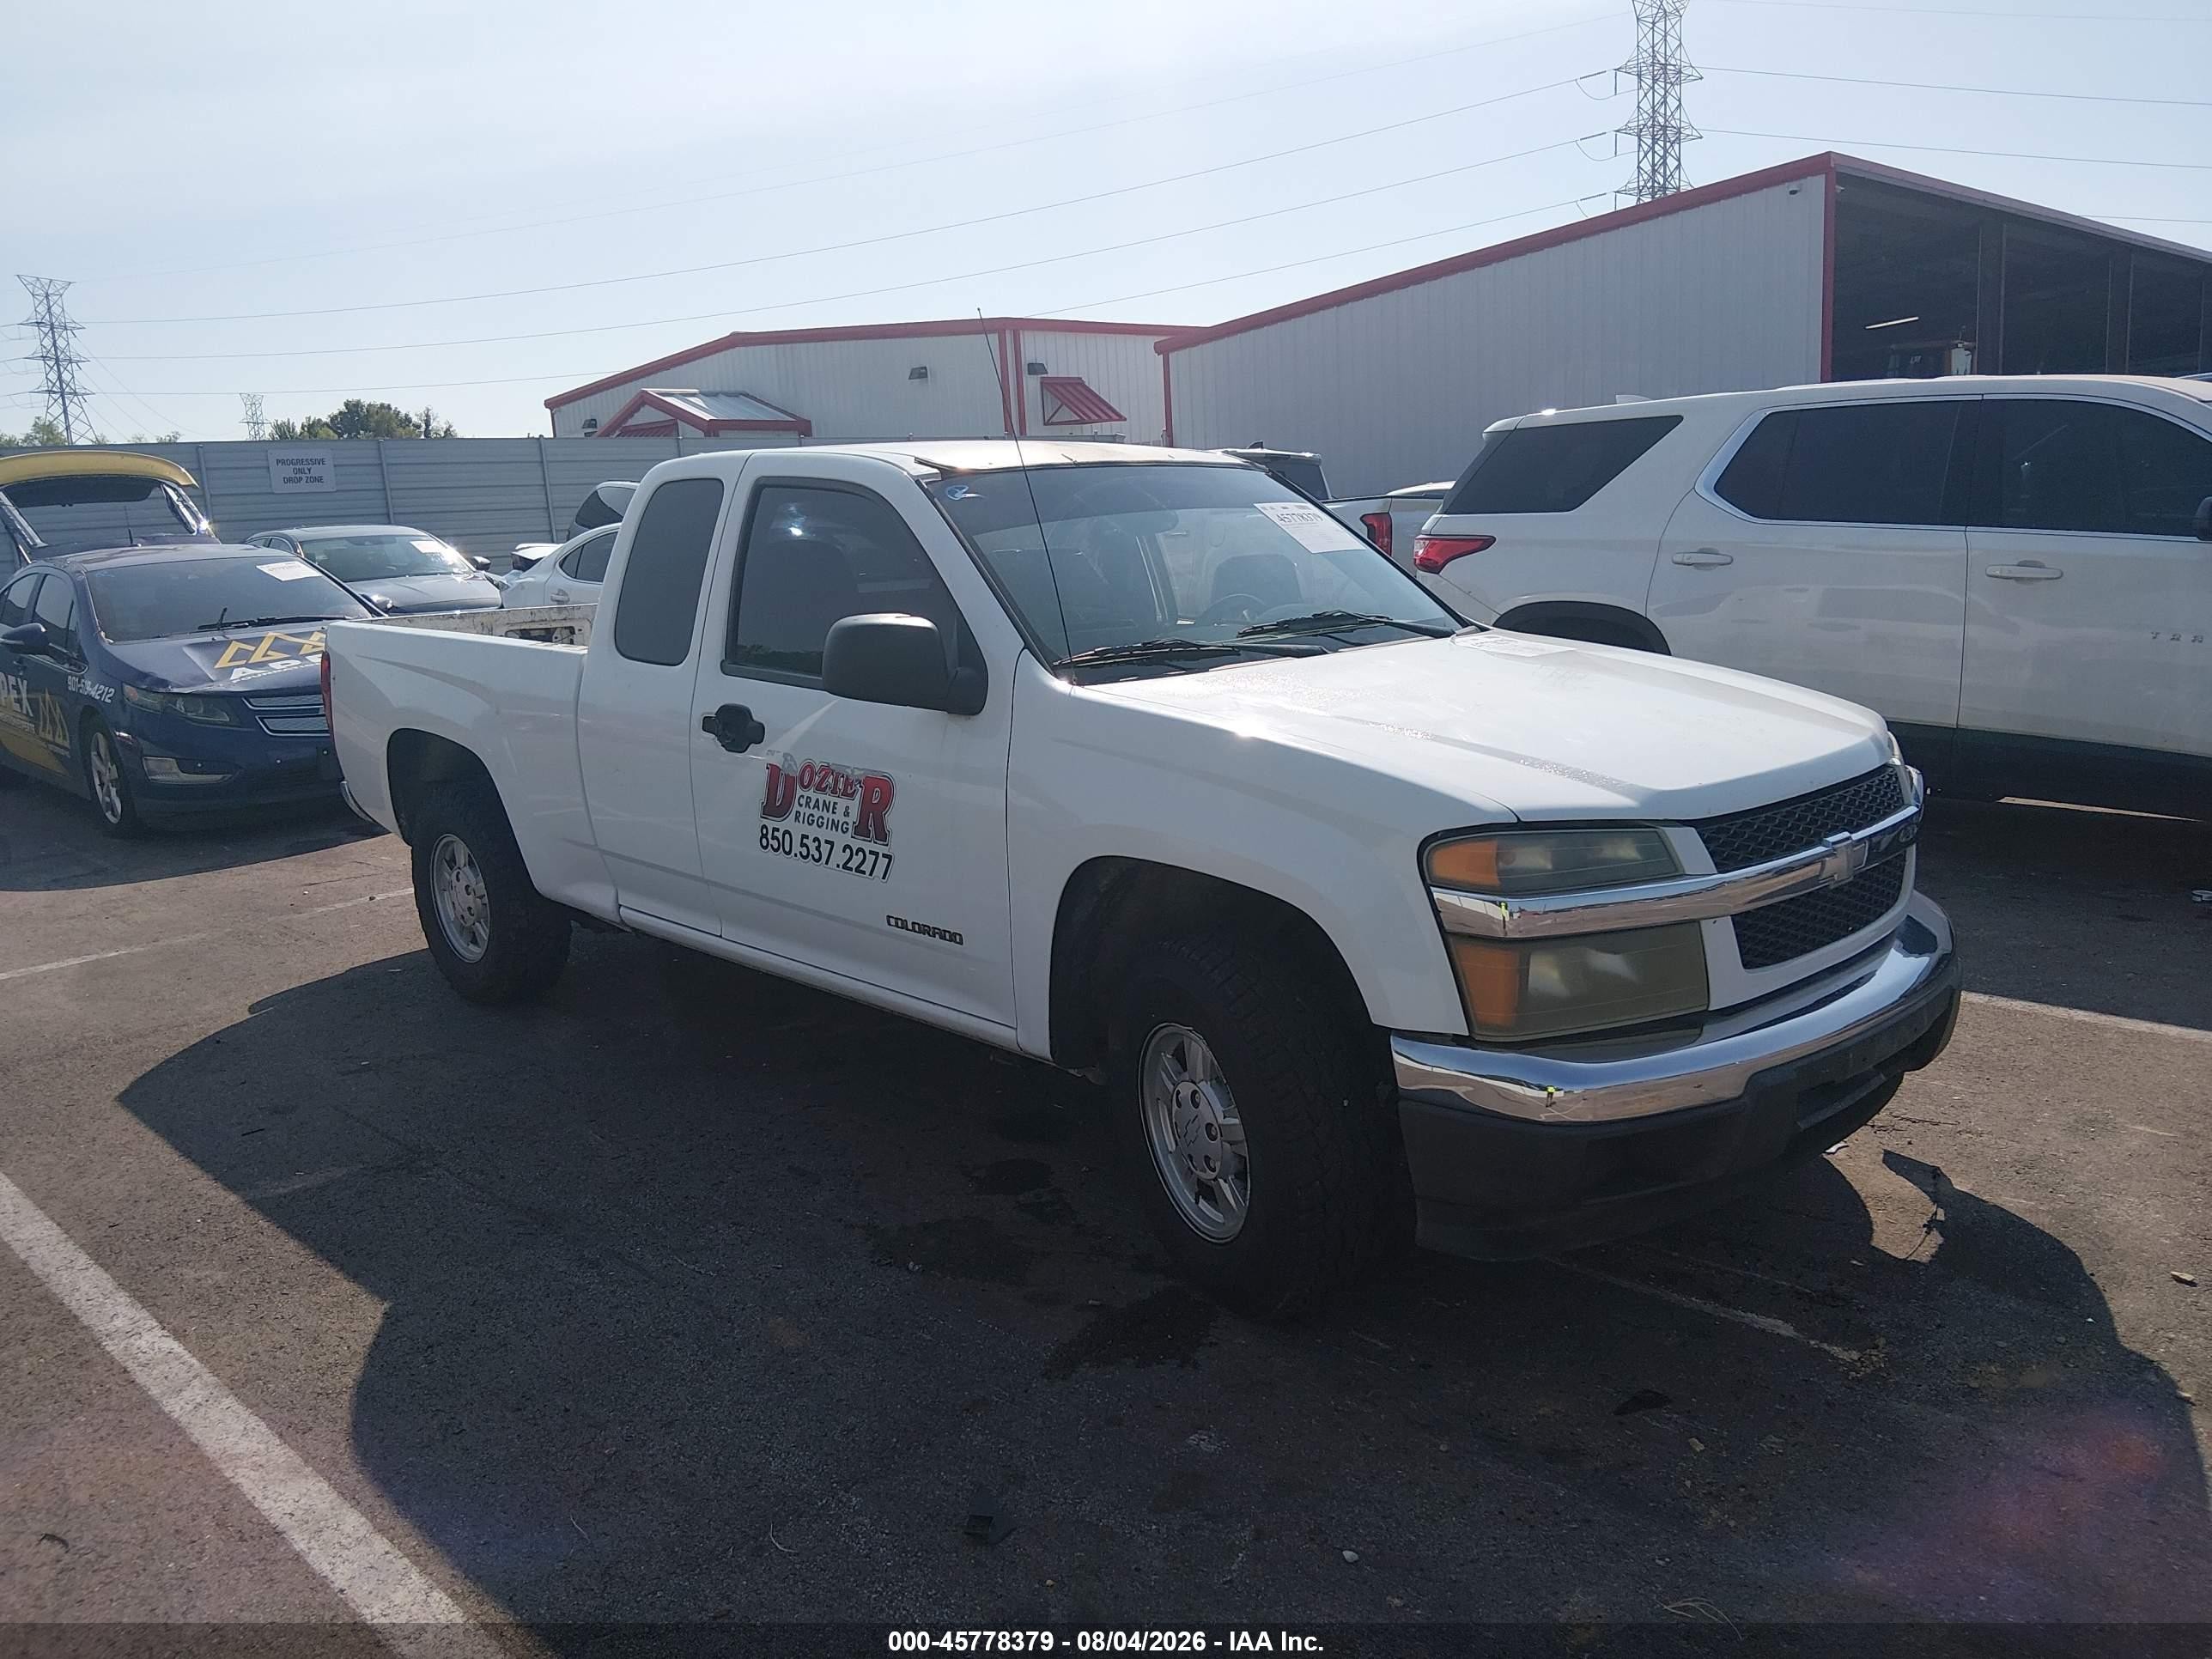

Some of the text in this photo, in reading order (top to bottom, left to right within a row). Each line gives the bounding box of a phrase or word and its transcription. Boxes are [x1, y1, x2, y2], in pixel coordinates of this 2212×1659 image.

[276, 458, 326, 466] PROGRESSIVE
[761, 759, 896, 847] DOZIER
[797, 794, 851, 817] CRANE &
[794, 811, 850, 835] RIGGING
[759, 824, 893, 880] 850.537.2277
[886, 915, 963, 945] COLORADO
